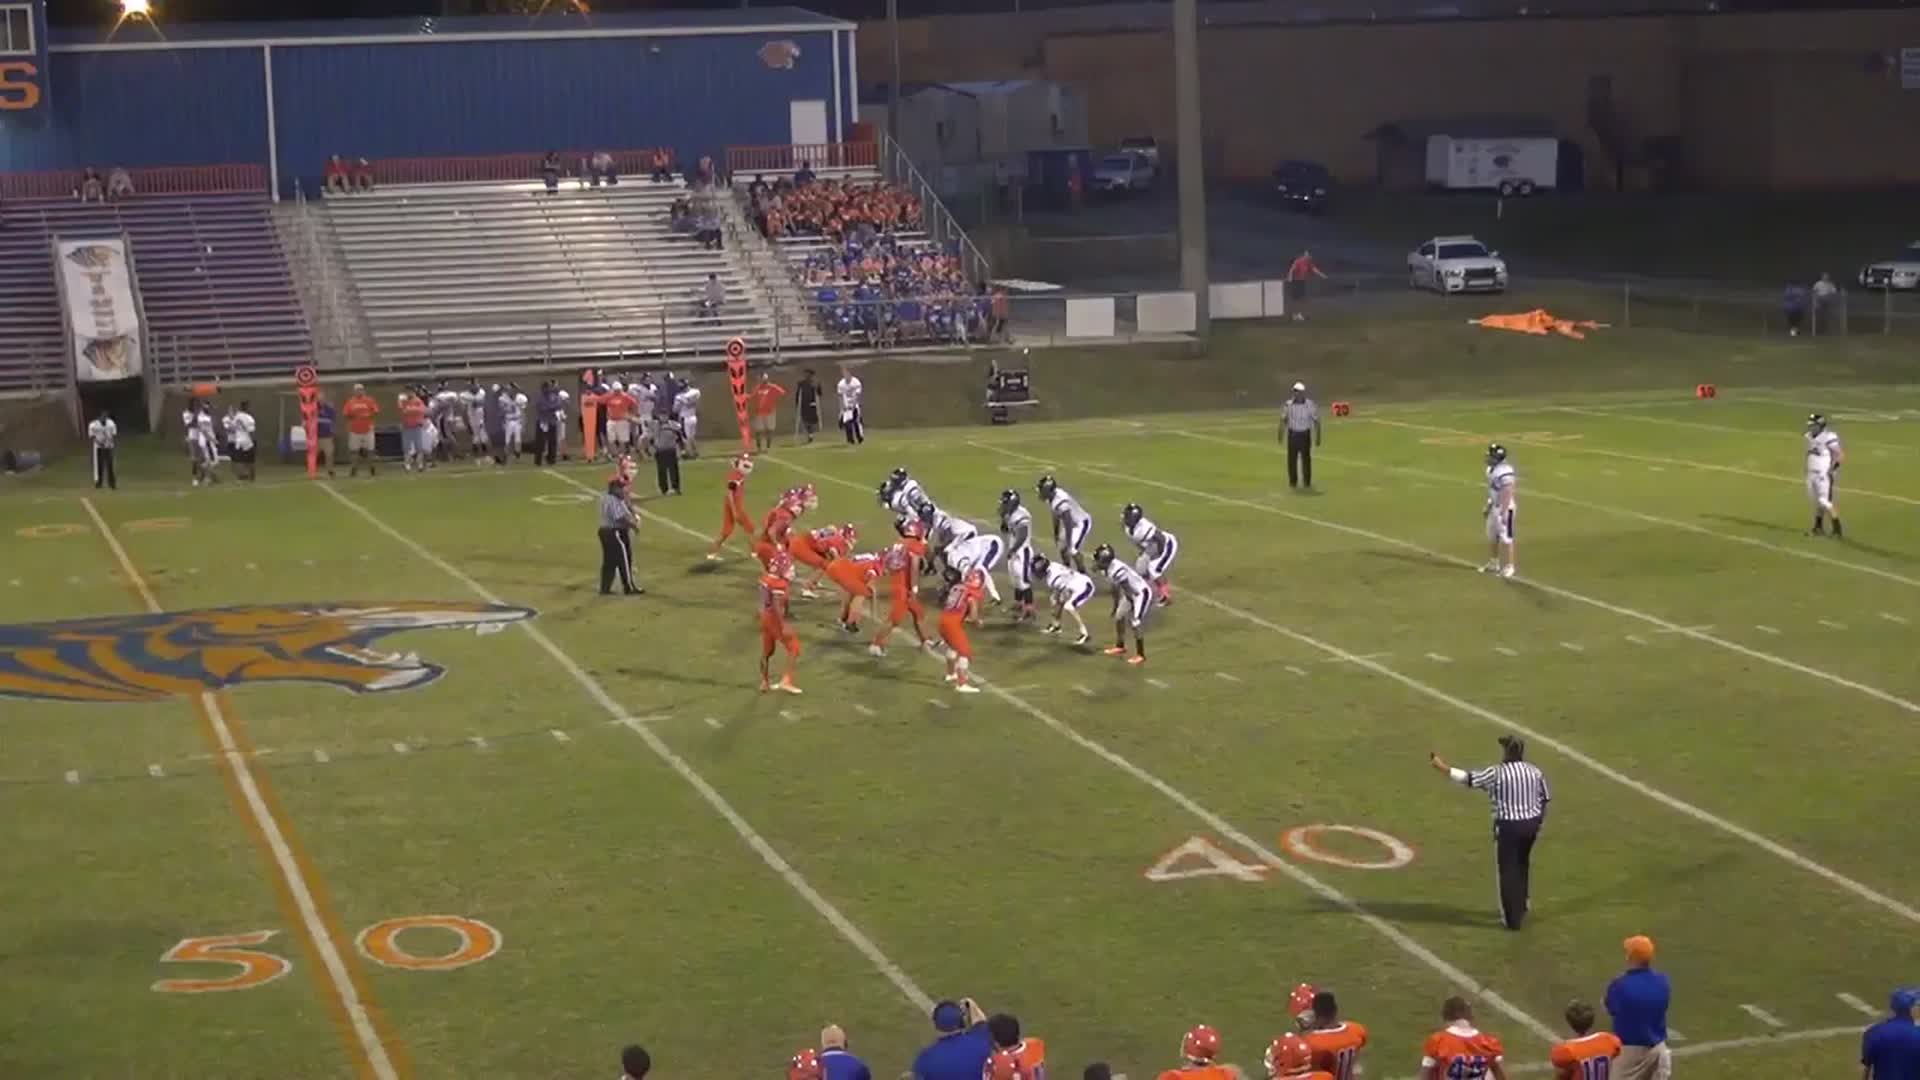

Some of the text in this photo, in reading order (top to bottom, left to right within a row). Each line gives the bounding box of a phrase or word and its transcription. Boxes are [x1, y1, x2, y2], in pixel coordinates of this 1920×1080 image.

[0, 62, 39, 109] S
[1333, 403, 1350, 416] 20
[1143, 824, 1416, 881] 40
[150, 914, 503, 992] 50
